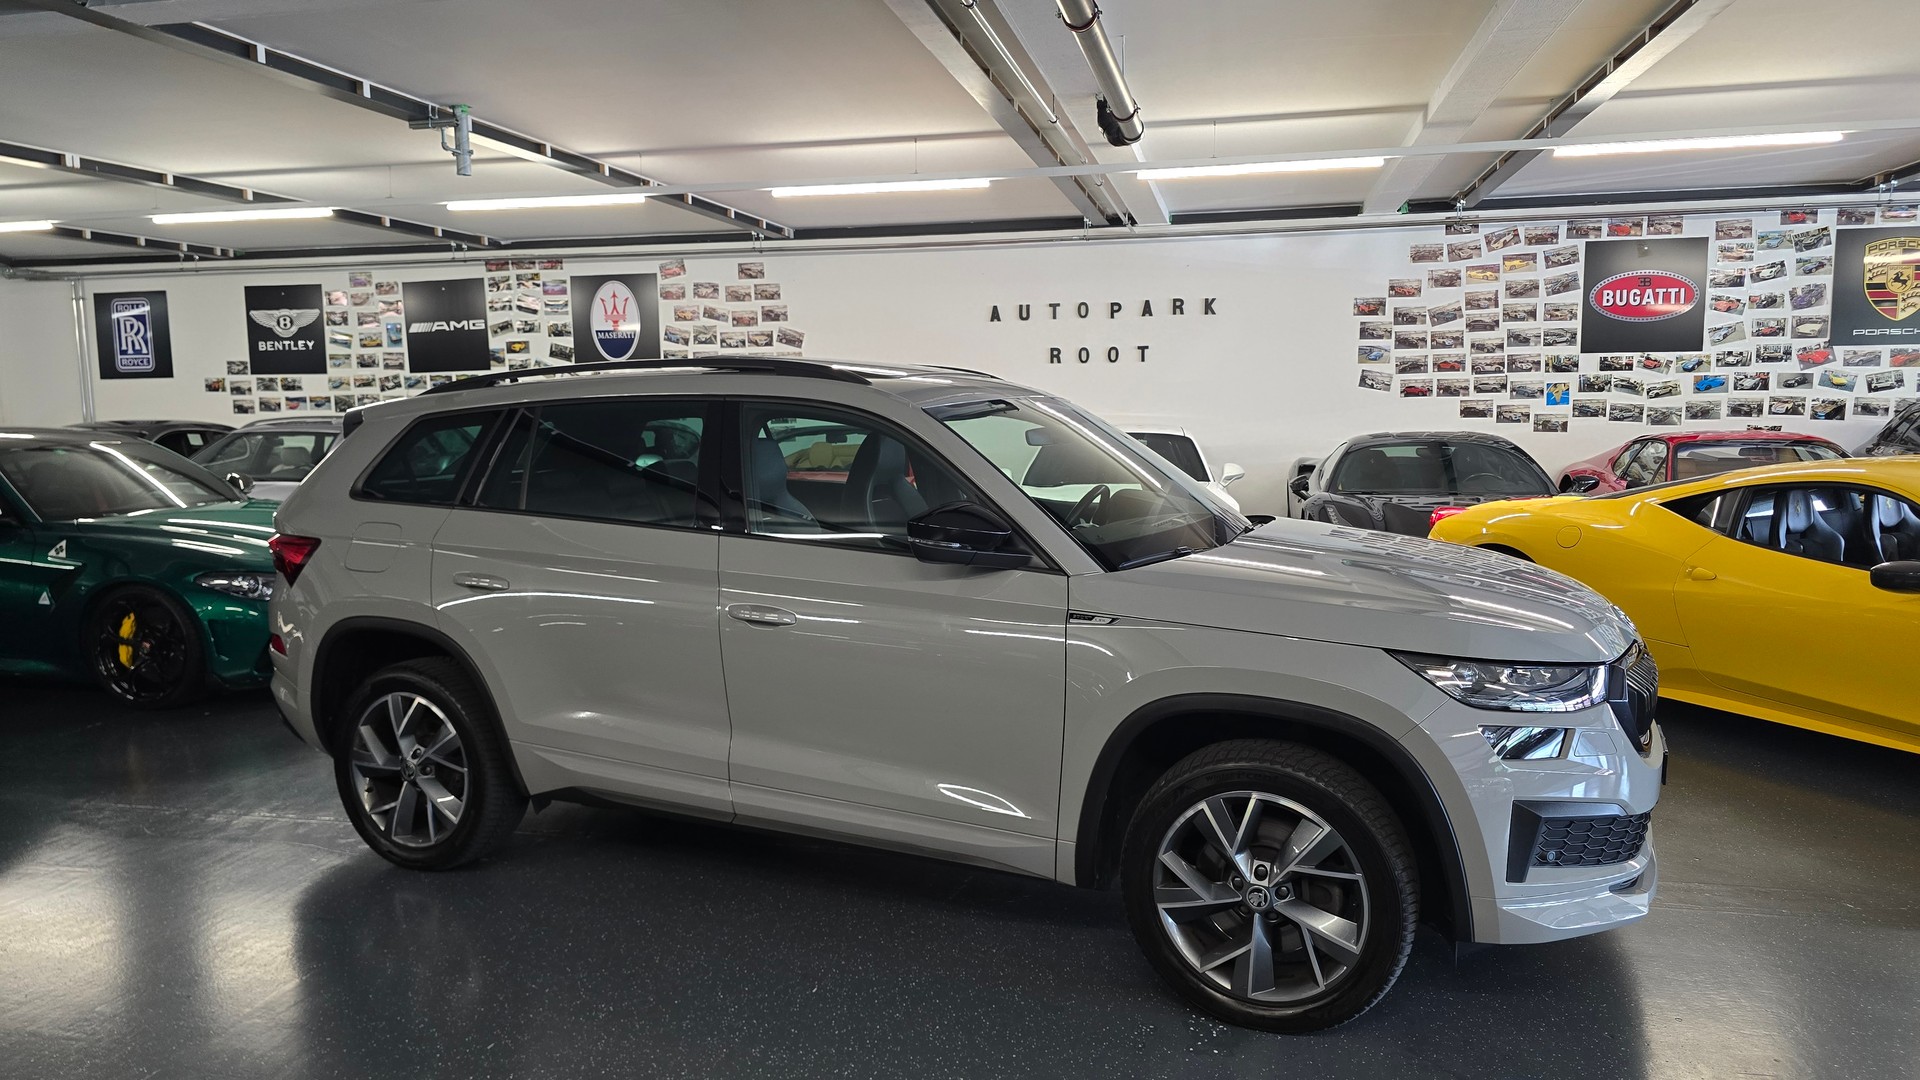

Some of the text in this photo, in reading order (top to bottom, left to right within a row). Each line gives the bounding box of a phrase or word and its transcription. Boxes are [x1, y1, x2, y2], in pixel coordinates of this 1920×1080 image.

[1602, 288, 1686, 307] BUGATTI
[432, 319, 486, 333] AMG
[597, 331, 635, 339] MASERATI
[258, 340, 315, 351] BENTLEY
[1050, 345, 1149, 364] ROOT
[121, 358, 149, 367] ROYCE
